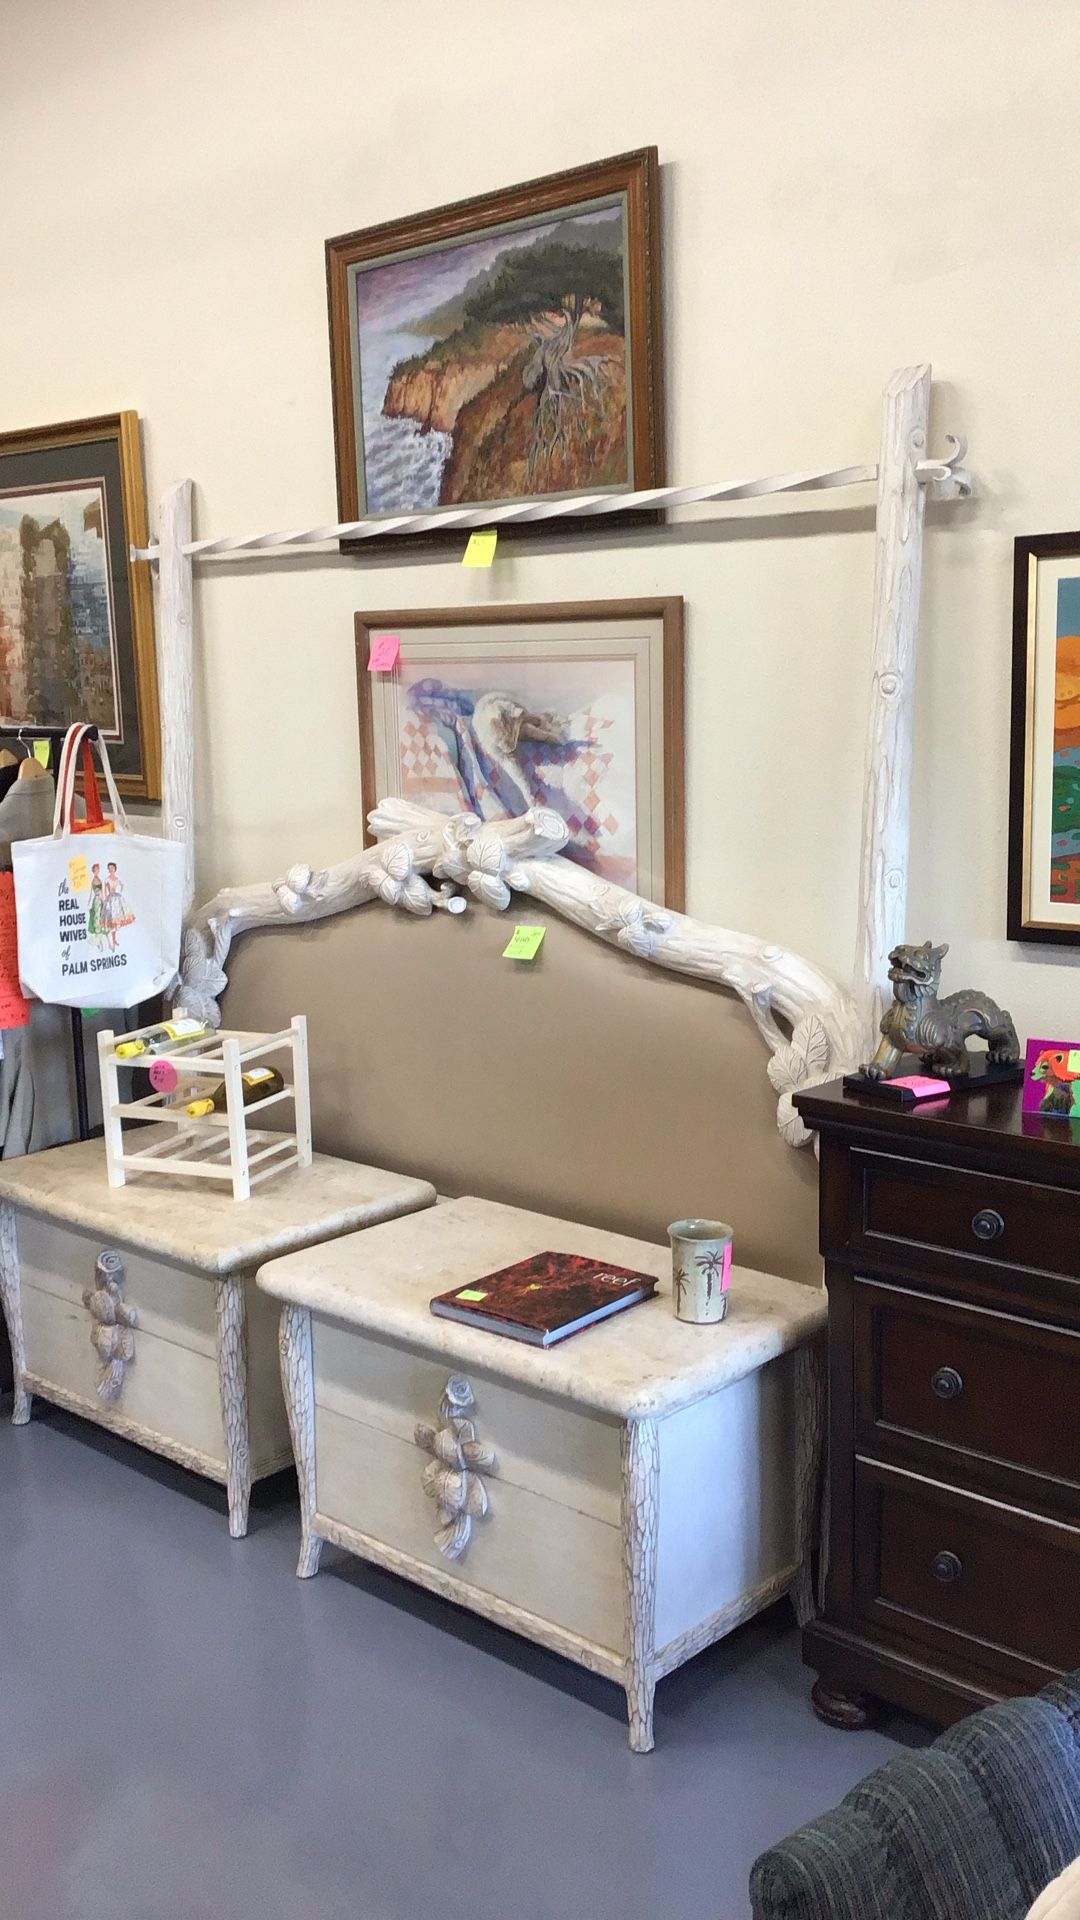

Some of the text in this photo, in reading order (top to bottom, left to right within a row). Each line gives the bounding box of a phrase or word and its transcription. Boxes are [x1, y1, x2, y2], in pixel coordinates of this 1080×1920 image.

[58, 878, 69, 897] the
[58, 899, 80, 912] REAL
[60, 912, 86, 926] HOUSE
[60, 928, 87, 942] WIVES
[61, 945, 71, 961] of
[62, 953, 128, 976] PALM SPRINGS
[593, 1272, 642, 1287] reef
